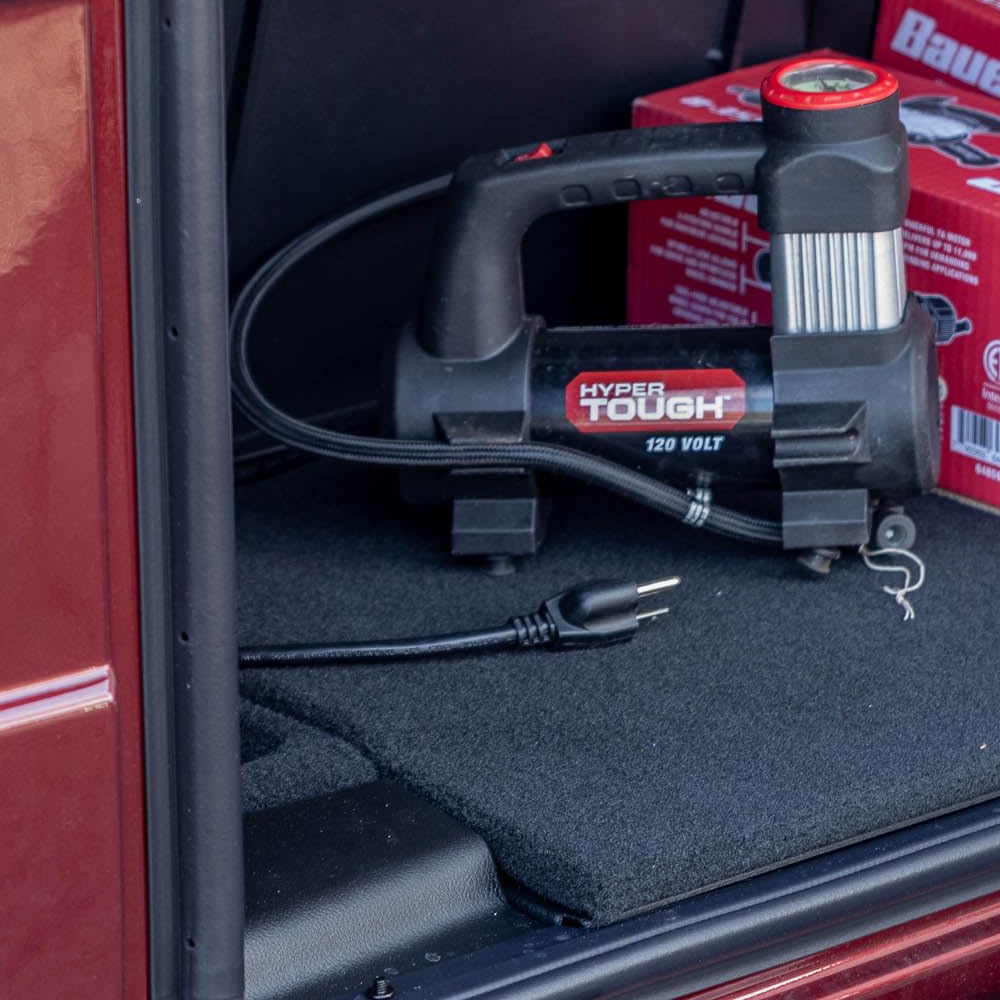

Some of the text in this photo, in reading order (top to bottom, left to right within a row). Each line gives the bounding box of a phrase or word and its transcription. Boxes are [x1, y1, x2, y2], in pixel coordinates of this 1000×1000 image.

[579, 382, 664, 398] HYPER
[579, 395, 723, 421] TOUGH
[646, 436, 725, 451] 120 VOLT
